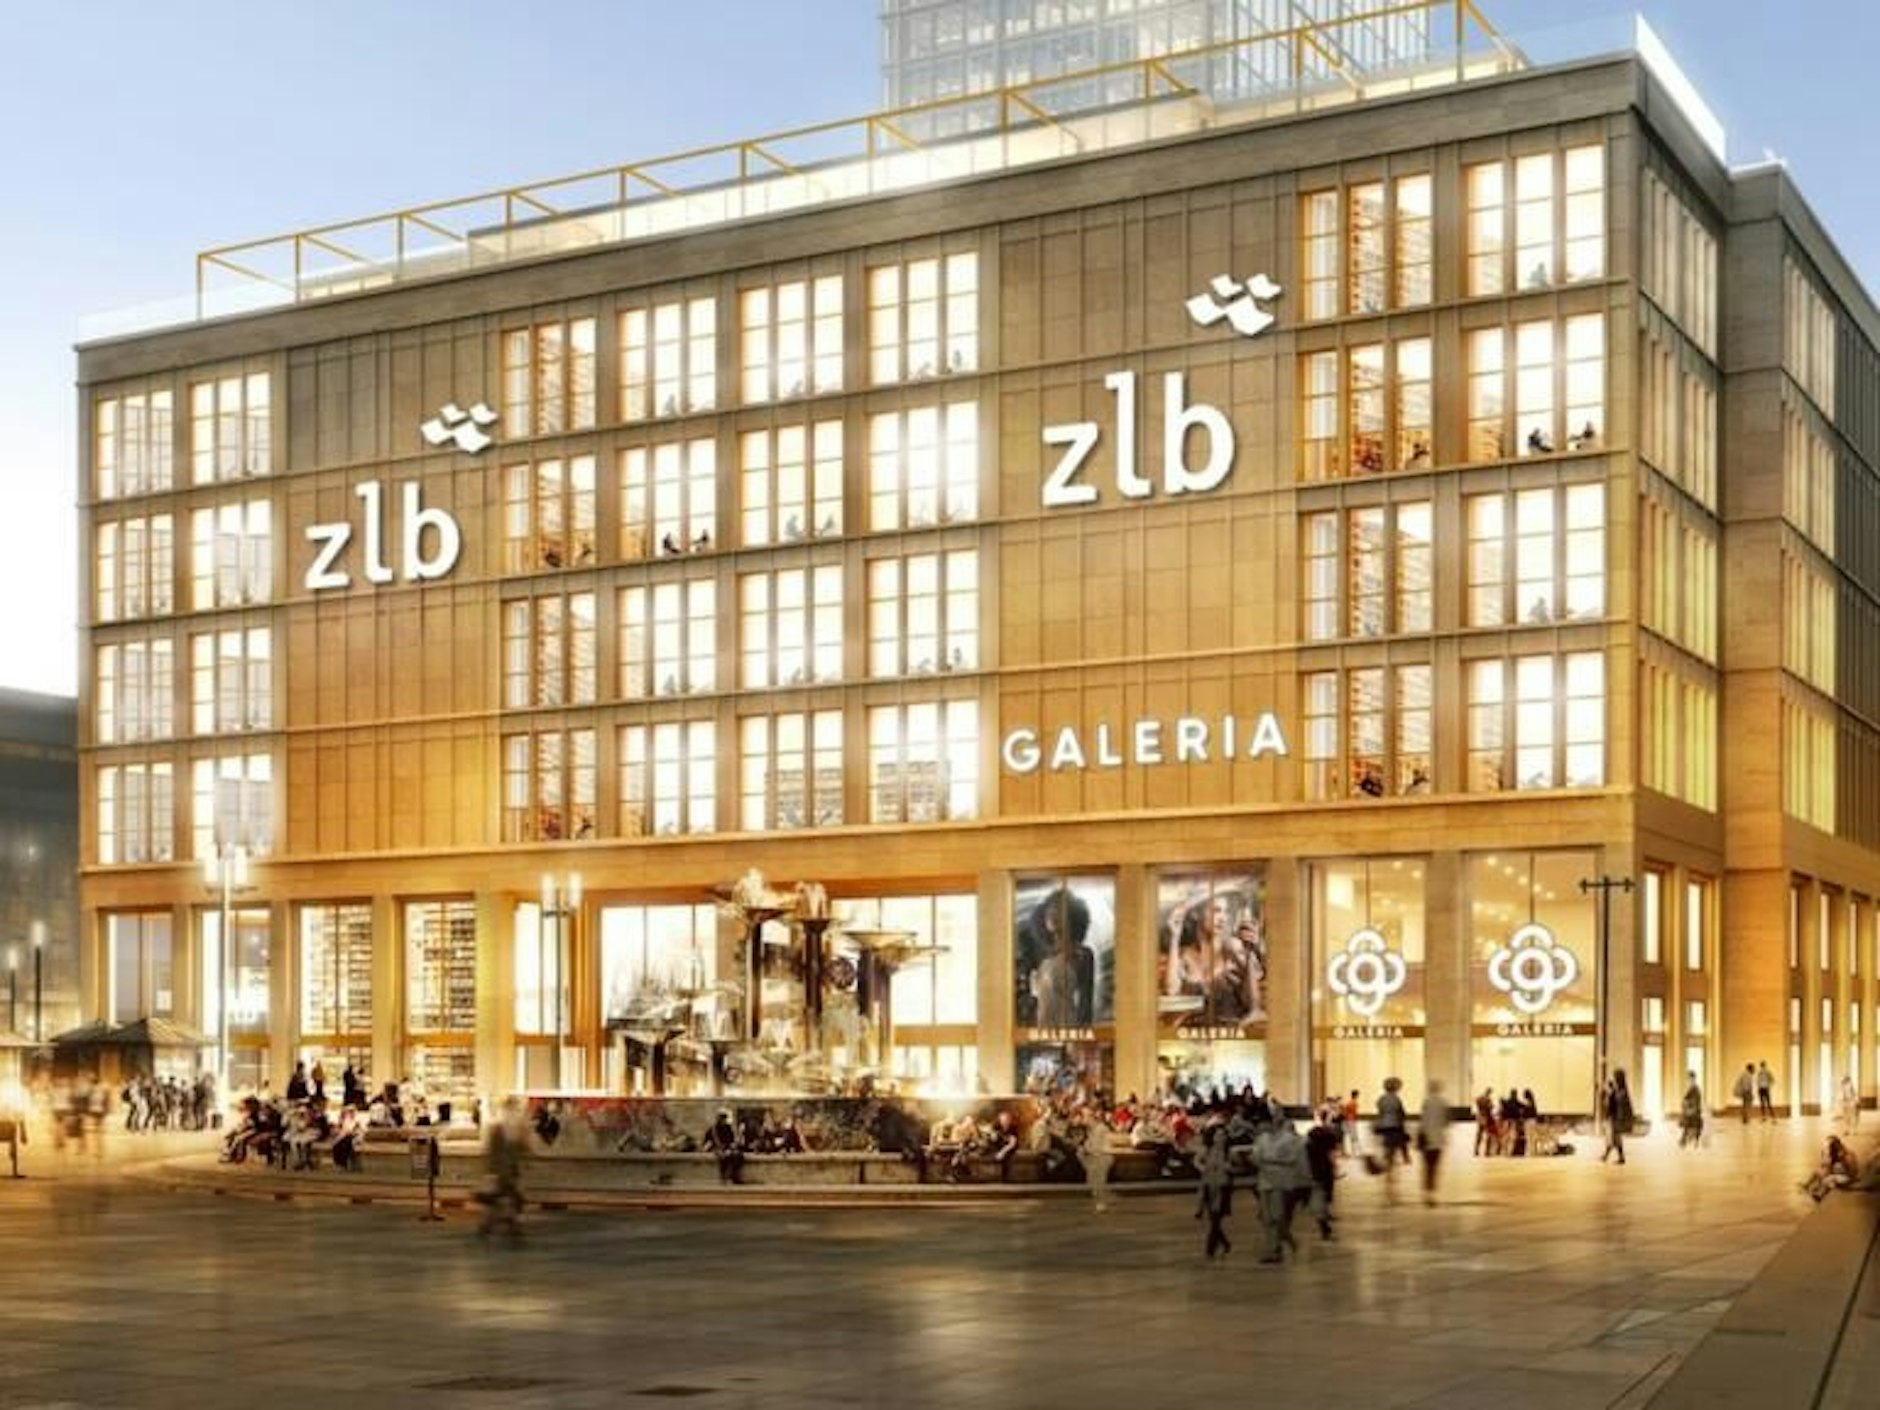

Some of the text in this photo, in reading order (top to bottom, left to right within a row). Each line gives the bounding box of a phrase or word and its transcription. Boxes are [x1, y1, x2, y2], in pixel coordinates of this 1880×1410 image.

[1041, 369, 1235, 506] zlb
[304, 480, 460, 589] zlb
[1003, 712, 1287, 772] GALERIA
[1028, 1028, 1096, 1042] GALERIA
[1176, 1026, 1246, 1040] GALERIA
[1333, 1026, 1404, 1039] GALERIA
[1497, 1022, 1574, 1036] GALERIA
